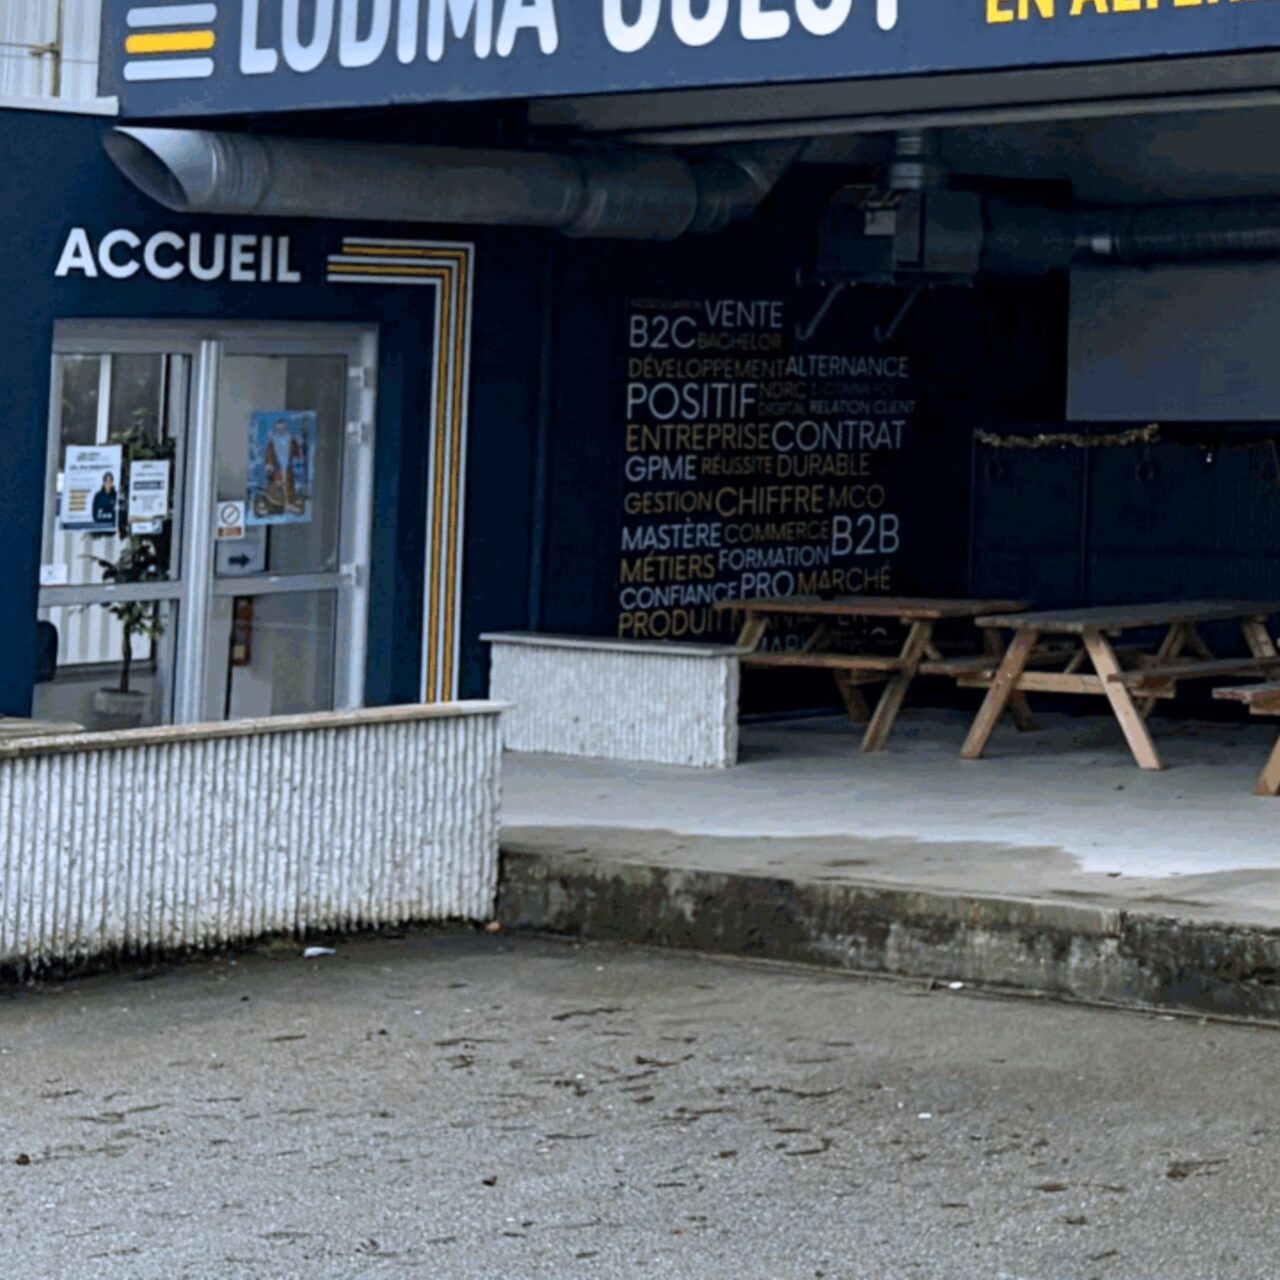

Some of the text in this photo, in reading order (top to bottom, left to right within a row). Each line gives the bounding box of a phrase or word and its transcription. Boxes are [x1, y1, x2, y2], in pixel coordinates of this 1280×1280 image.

[54, 227, 302, 283] ACCUEIL
[704, 299, 784, 329] VENTE
[629, 314, 697, 349] B2C
[697, 331, 784, 351] BACHELOR
[628, 353, 910, 379] DÉVELOPPEMENT ALTERNANCE
[626, 382, 757, 420] POSITIF
[625, 420, 906, 452] ENTREPRISE CONTRAT
[624, 454, 698, 482] GPME
[776, 452, 870, 478] DURABLE
[624, 484, 886, 518] GESTION CHIFFRE MCO
[621, 513, 900, 556] MASTÈRE COMMERCE B2B
[619, 544, 830, 584] MÉTIERS FORMATION
[619, 559, 891, 611] CONFIANCE PRO MARCHÉ
